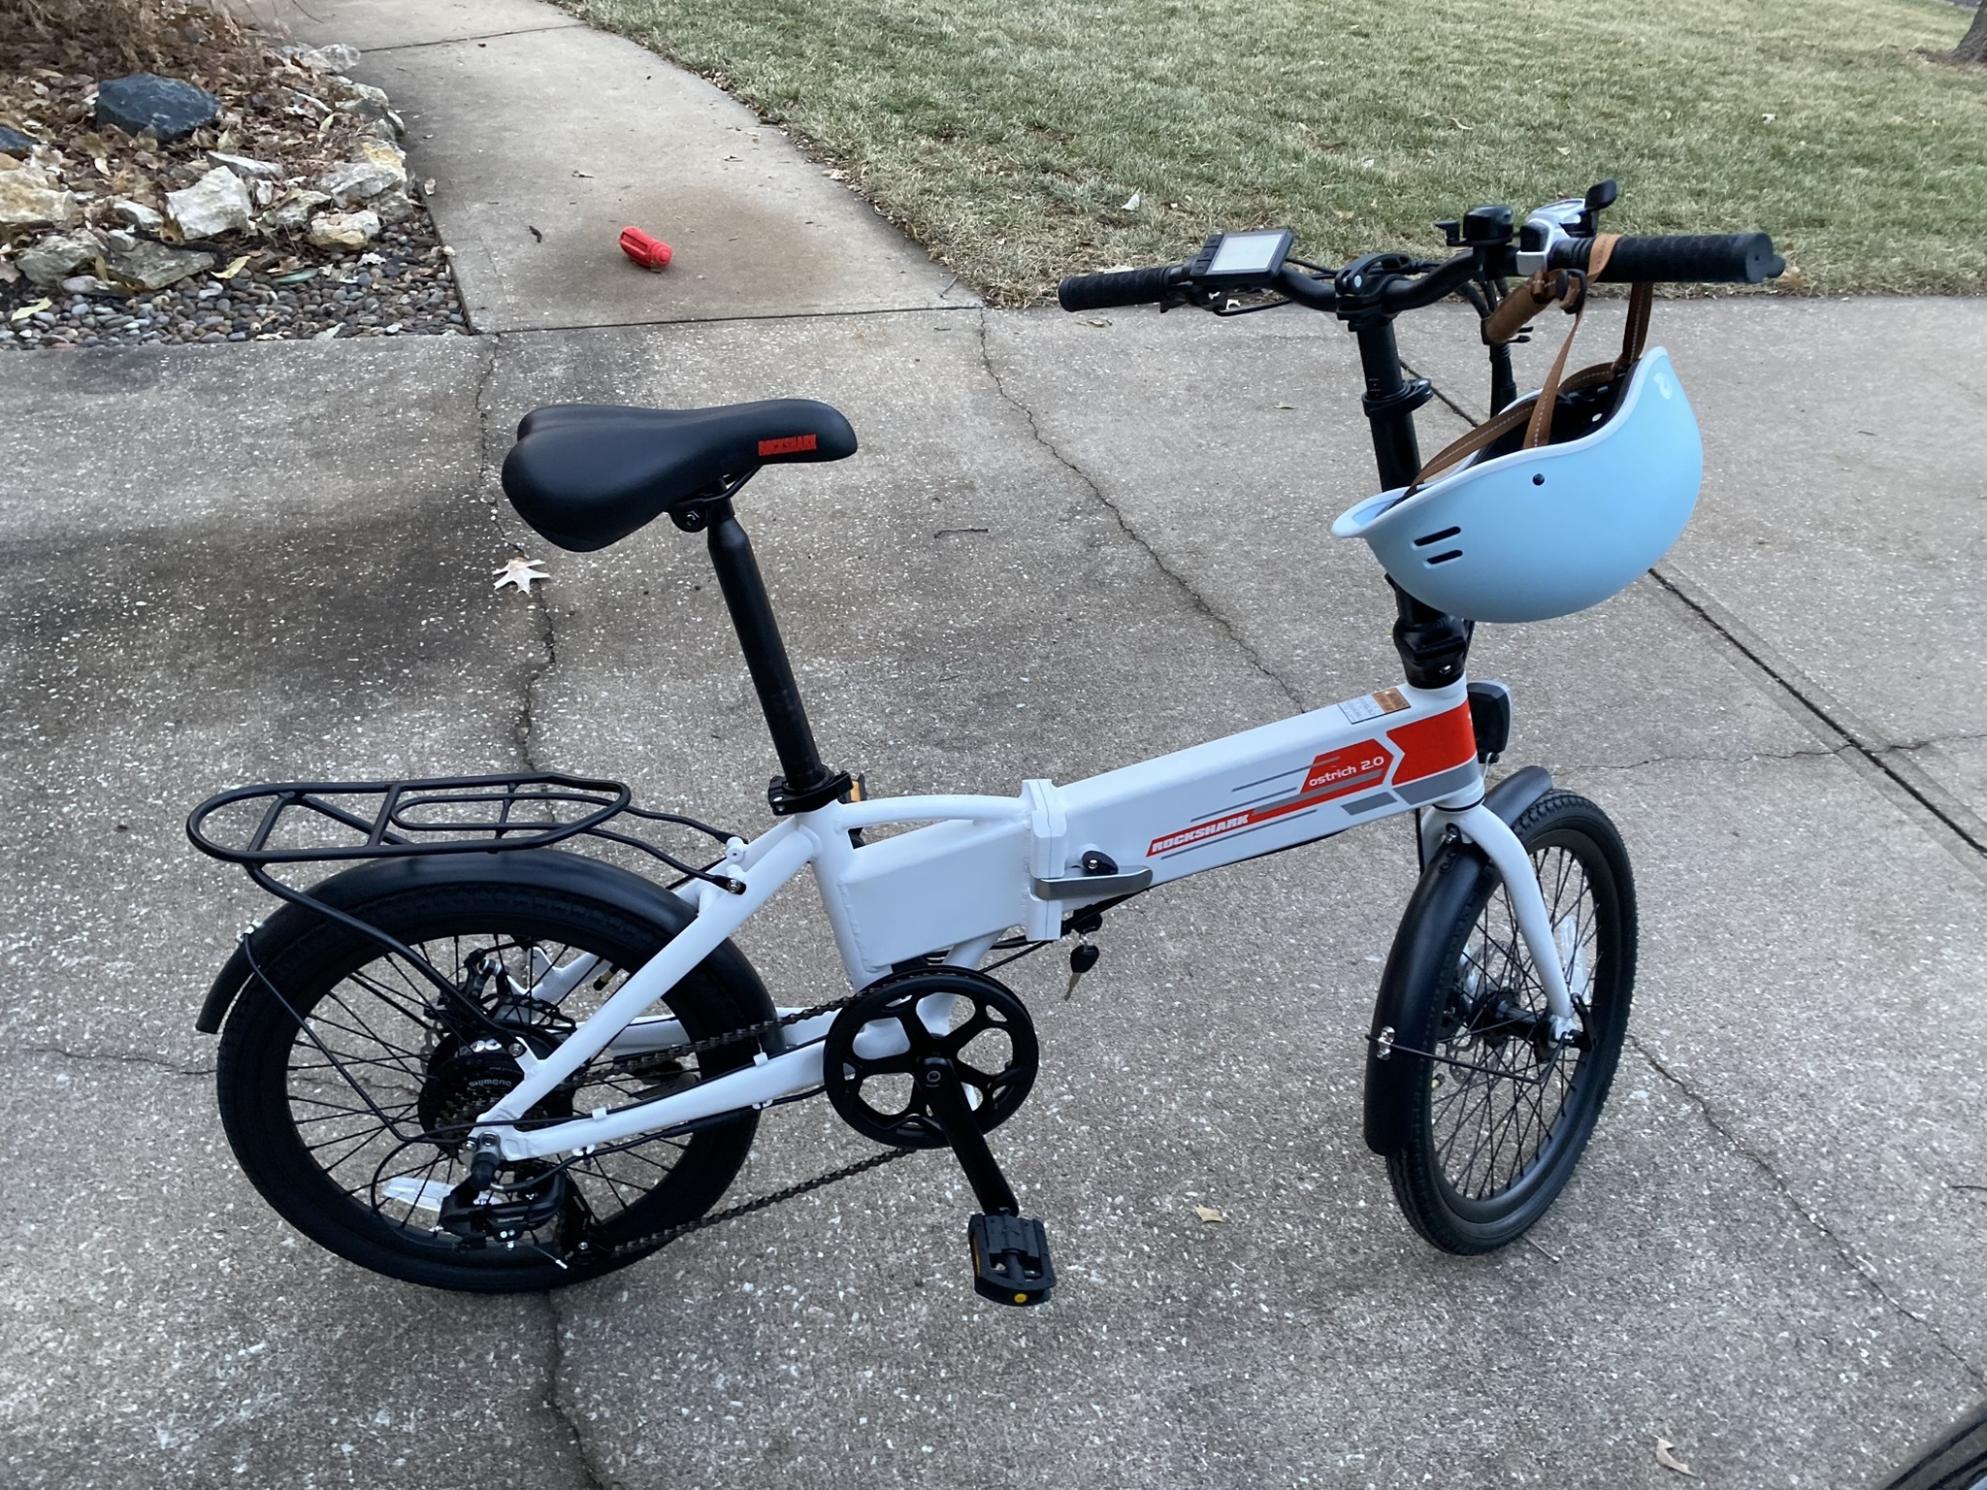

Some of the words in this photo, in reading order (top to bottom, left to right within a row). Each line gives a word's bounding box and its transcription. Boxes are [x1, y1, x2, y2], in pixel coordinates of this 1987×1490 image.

[1308, 765, 1357, 787] ostrich
[1360, 755, 1385, 771] 2.0
[1151, 814, 1249, 853] ROCKSHARK
